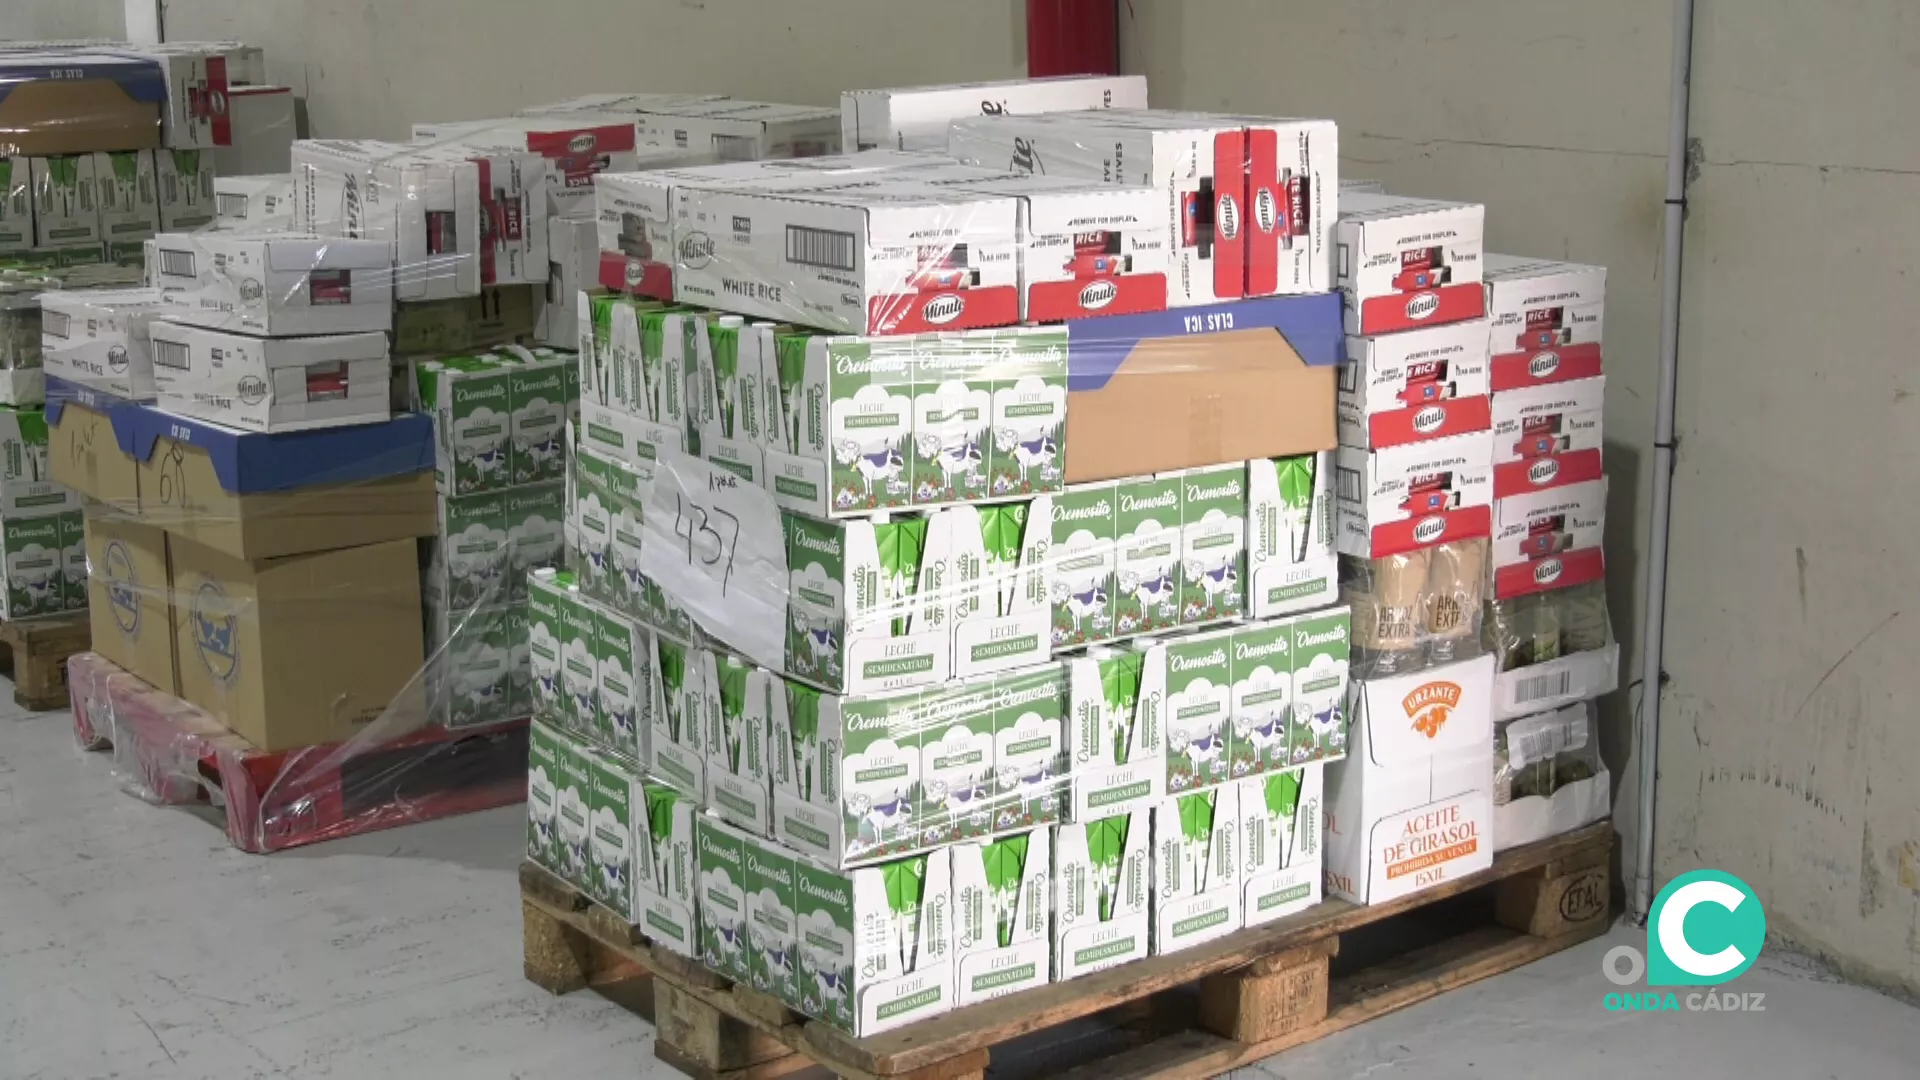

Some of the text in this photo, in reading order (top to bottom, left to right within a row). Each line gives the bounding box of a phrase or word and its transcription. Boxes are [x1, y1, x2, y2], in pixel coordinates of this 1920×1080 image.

[1073, 215, 1132, 226] REMOVE FOR DISPLAY
[1259, 188, 1273, 233] Minute
[1291, 195, 1303, 228] RICE
[1075, 232, 1103, 244] RICE
[678, 236, 716, 264] Minute
[1403, 248, 1427, 263] RICE
[721, 277, 755, 298] WHITE
[757, 281, 782, 302] RICE
[1080, 284, 1118, 305] Minute
[922, 297, 965, 319] Minute
[1405, 293, 1440, 317] Minute
[1527, 308, 1551, 322] RICE
[996, 344, 1063, 368] Cremosita
[1529, 354, 1560, 375] Minute
[1414, 361, 1438, 375] RICE
[859, 402, 885, 414] LECHE
[1019, 391, 1042, 402] LECHE
[845, 415, 898, 428] SEMIDESNATADA
[1413, 407, 1446, 428] Minute
[1529, 460, 1559, 481] Minute
[1120, 489, 1178, 512] Cremosita
[1186, 479, 1241, 502] Cremosita
[1050, 499, 1113, 523] Cremosita
[1414, 518, 1446, 540] Minute
[795, 526, 842, 557] Cremosita
[1286, 567, 1313, 581] LECHE
[1534, 559, 1563, 581] Minute
[1269, 579, 1327, 602] SEMIDESNATADA
[989, 624, 1021, 639] LECHE
[1296, 623, 1348, 649] Cremosita
[1378, 622, 1410, 638] EXTRA
[884, 642, 917, 658] LECHE
[972, 637, 1037, 661] SEMIDESNATADA
[1235, 635, 1289, 660] Cremosita
[864, 656, 933, 679] SEMIDESNATADA
[1170, 648, 1228, 673] Cremosita
[1000, 681, 1058, 707] Cremosita
[1405, 686, 1457, 710] URZANTE
[1018, 727, 1040, 739] LECHE
[1006, 737, 1052, 756] SEMIDESNATADA
[869, 755, 896, 768] LECHE
[855, 766, 908, 782] SEMIDESNATADA
[1105, 771, 1134, 787] LECHE
[592, 772, 628, 807] Cremosita
[1089, 783, 1150, 806] SEMIDESNATADA
[1402, 804, 1461, 836] ACEITE
[701, 833, 742, 866] Cremosita
[1384, 821, 1481, 864] DE GIRASOL
[747, 853, 792, 889] Cremosita
[1389, 842, 1475, 877] PROHIBIDA SU VENTA
[799, 873, 848, 909] Cremosita
[1062, 861, 1076, 926] Cremosita
[1271, 875, 1297, 890] LECHE
[1187, 900, 1212, 916] LECHE
[1258, 884, 1310, 911] SEMIDESNATADA
[1091, 927, 1120, 944] LECHE
[1173, 911, 1228, 937] SEMIDESNATADA
[990, 953, 1020, 970] LECHE
[1075, 939, 1134, 964] SEMIDESNATADA
[895, 976, 925, 997] LECHE
[972, 965, 1035, 991] SEMIDESNATADA
[877, 988, 941, 1020] SEMIDESNATADA
